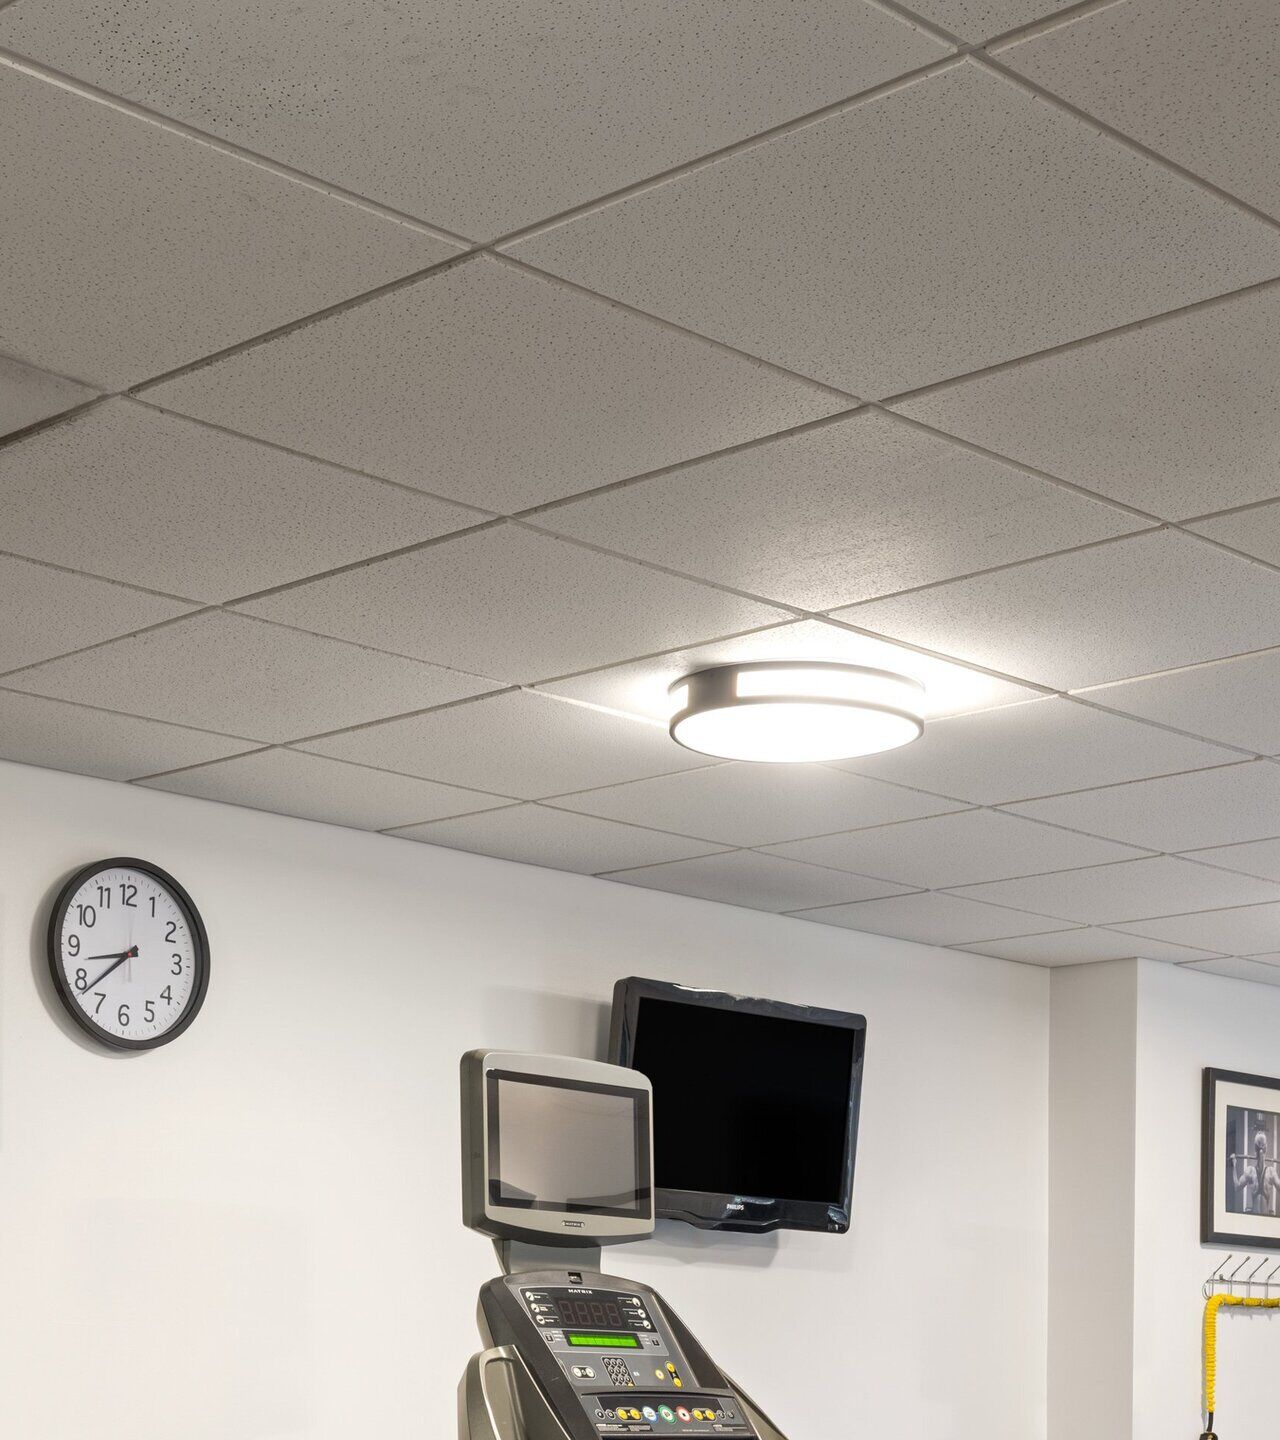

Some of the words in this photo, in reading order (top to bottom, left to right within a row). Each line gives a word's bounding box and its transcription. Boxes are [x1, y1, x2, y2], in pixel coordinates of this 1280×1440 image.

[97, 886, 111, 909] 11
[119, 883, 138, 908] 12
[149, 896, 156, 918] 1
[77, 904, 97, 928] 10
[165, 921, 177, 944] 2
[67, 934, 81, 957] 9
[170, 953, 183, 976] 3
[74, 968, 88, 991] 8
[94, 992, 107, 1014] 7
[160, 984, 173, 1006] 4
[117, 1004, 130, 1027] 6
[143, 1000, 155, 1023] 5
[726, 1203, 745, 1211] PHILIPS
